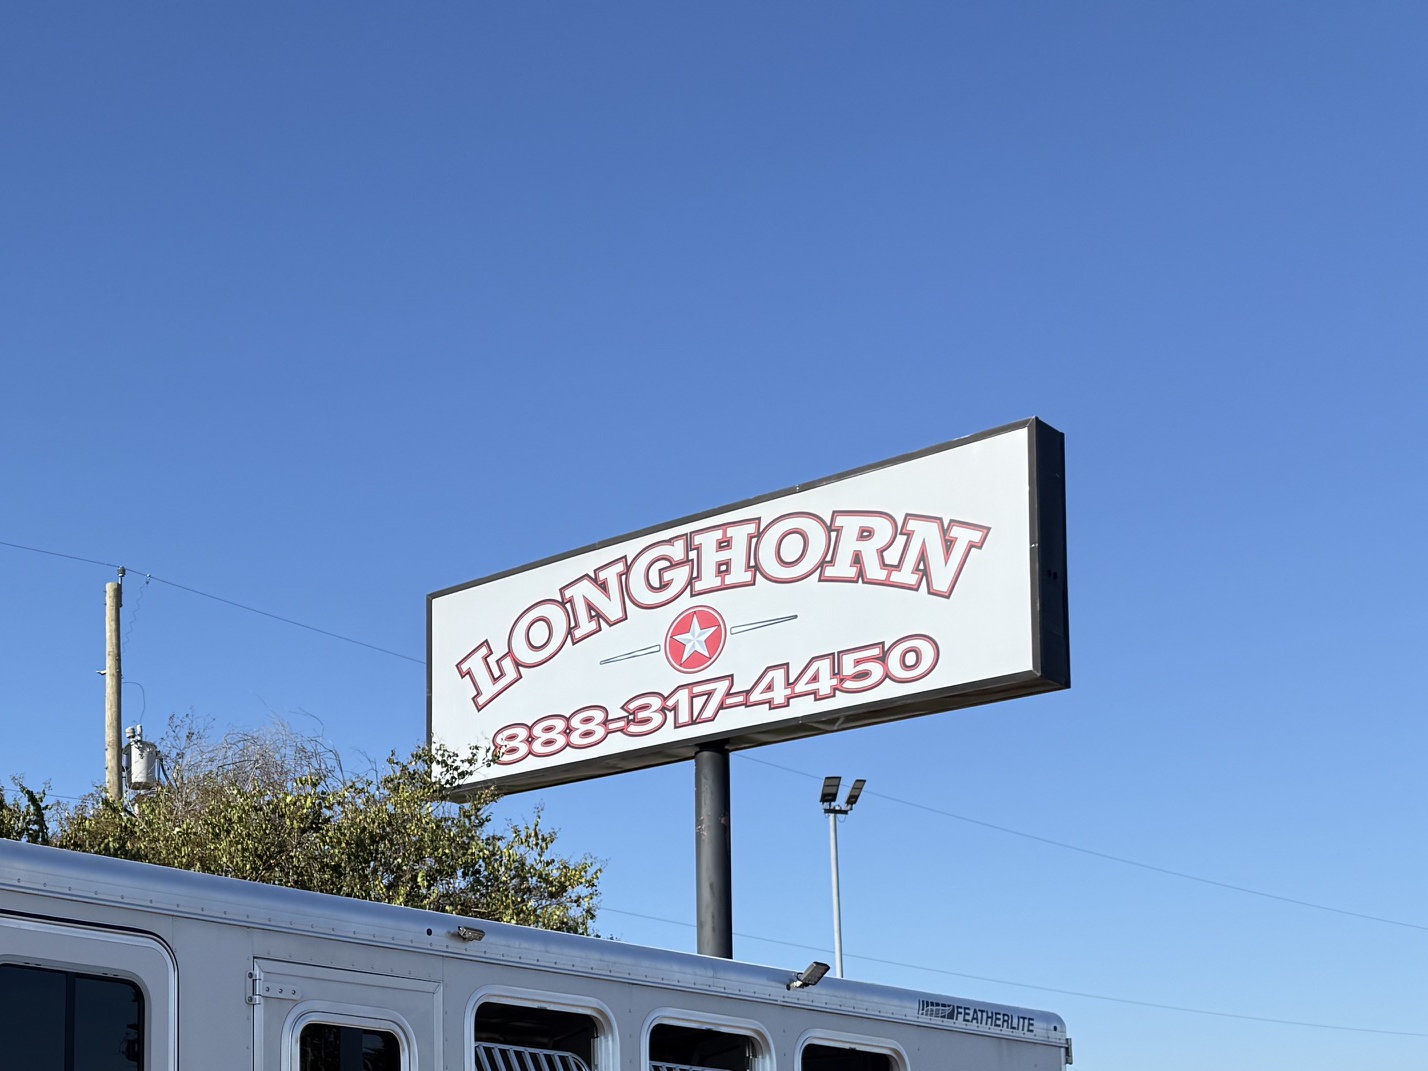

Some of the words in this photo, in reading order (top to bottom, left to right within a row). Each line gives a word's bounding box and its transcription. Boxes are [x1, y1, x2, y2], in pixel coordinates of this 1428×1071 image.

[456, 510, 992, 713] LONGHORN
[491, 633, 940, 766] 888-317-4450
[955, 1005, 1035, 1033] FEATHERLITE
